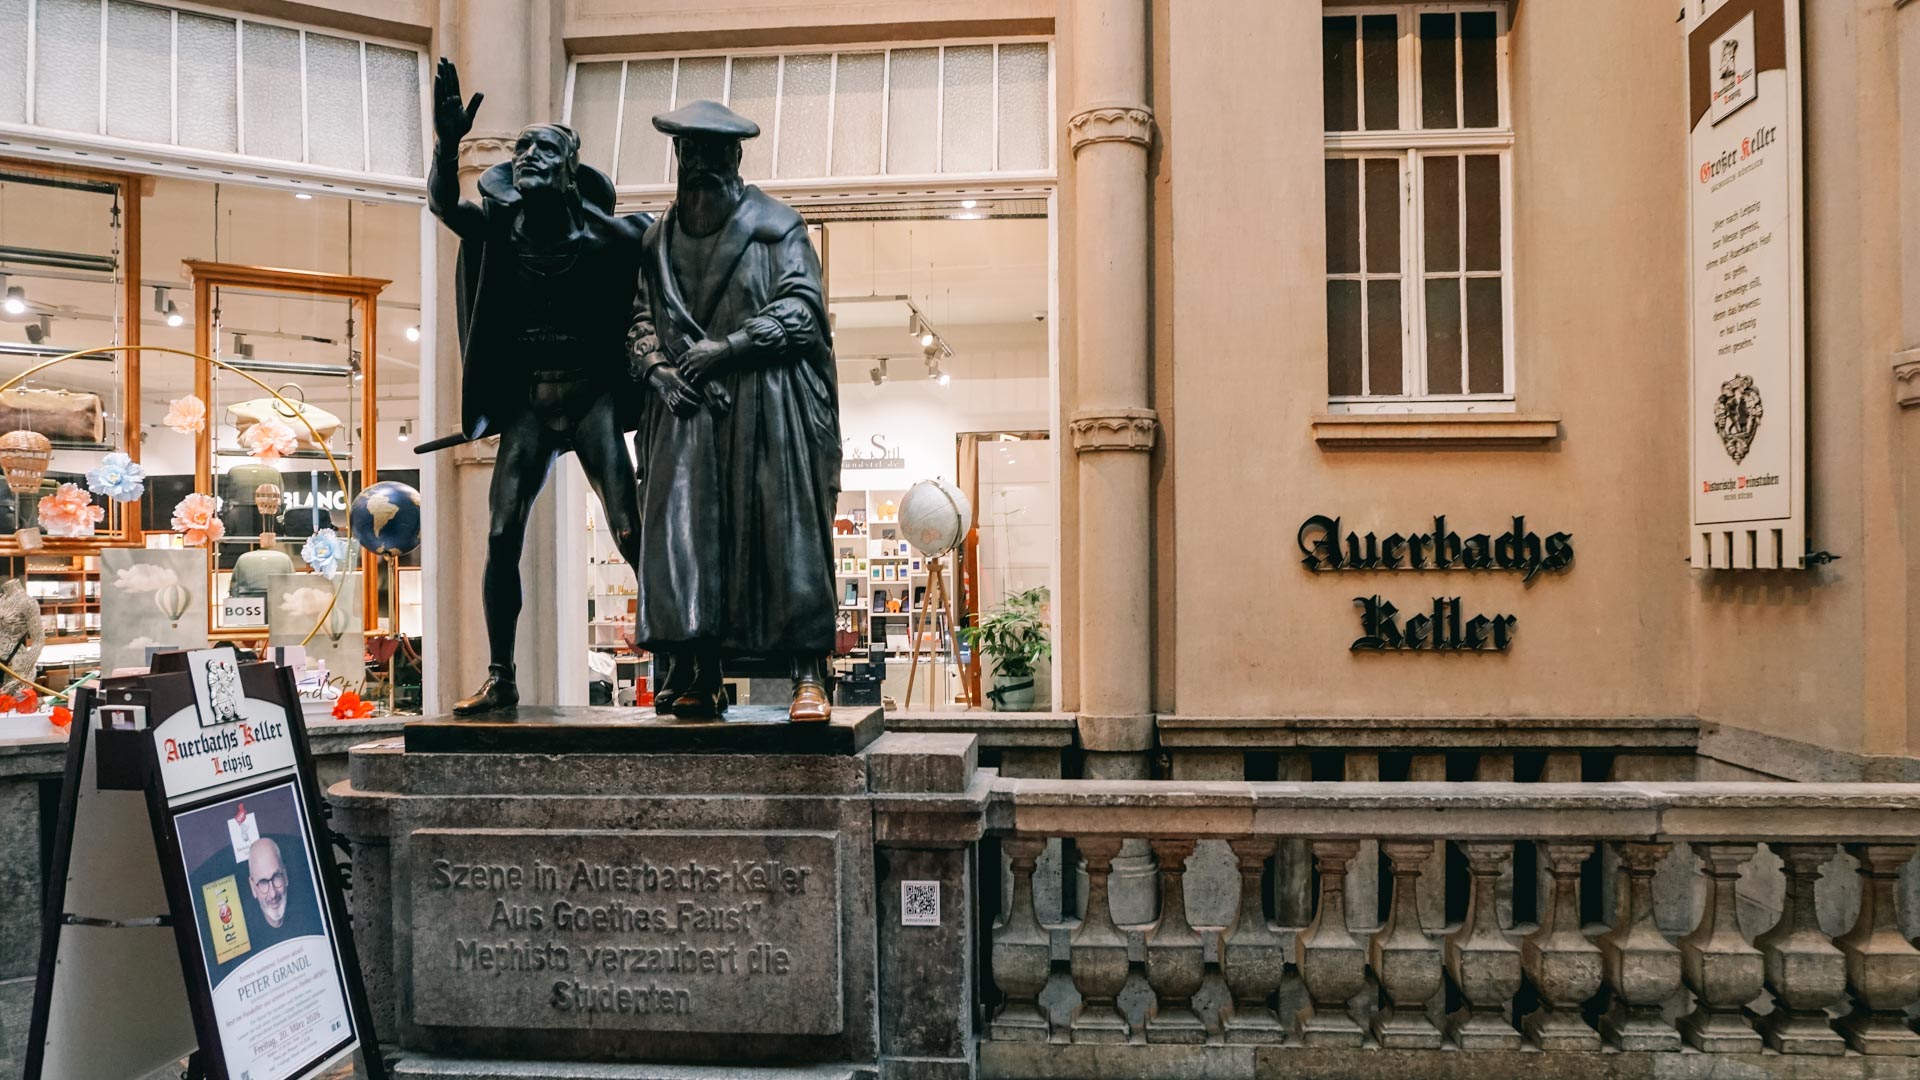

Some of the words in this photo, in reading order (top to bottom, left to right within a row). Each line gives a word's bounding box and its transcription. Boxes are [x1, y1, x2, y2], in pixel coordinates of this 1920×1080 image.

[1700, 149, 1738, 184] Großer
[1740, 126, 1777, 161] Keller
[1297, 514, 1574, 583] Auerbachs
[225, 606, 261, 616] BOSS
[1349, 594, 1518, 650] Keller
[164, 729, 239, 763] Auerbachs
[239, 720, 283, 747] Keller
[211, 752, 254, 775] Leipzig
[431, 859, 524, 890] Szene
[534, 859, 558, 891] in
[487, 898, 544, 931] Aus
[552, 898, 667, 933] Goethes
[456, 938, 571, 975] Mephisto
[581, 942, 738, 973] verzaubert
[749, 942, 791, 974] die
[237, 975, 270, 1002] PETER
[272, 954, 312, 984] GRANDL
[551, 980, 693, 1014] Studenten
[289, 1020, 305, 1034] März
[306, 1011, 321, 1024] 2026
